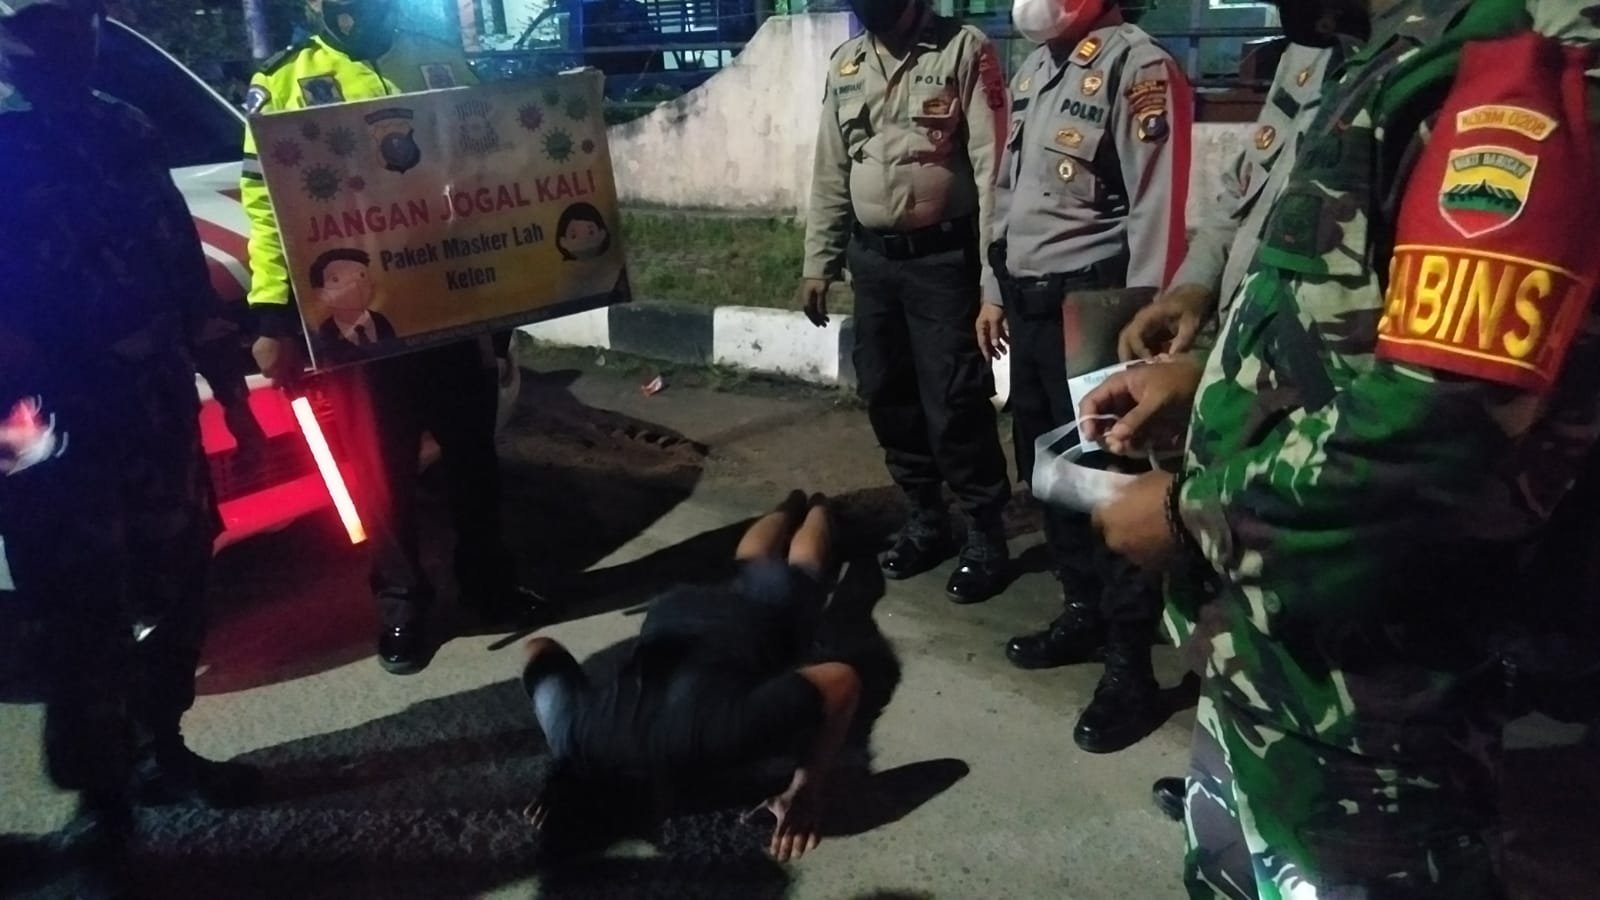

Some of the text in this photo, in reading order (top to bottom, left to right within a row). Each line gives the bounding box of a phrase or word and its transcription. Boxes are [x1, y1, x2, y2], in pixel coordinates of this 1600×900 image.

[1061, 99, 1104, 123] POLRI
[1508, 111, 1547, 136] 0208
[307, 170, 596, 243] JANGAN JOGAL KALI
[380, 223, 544, 272] Pakek Masker Lah
[446, 264, 497, 291] Kelen
